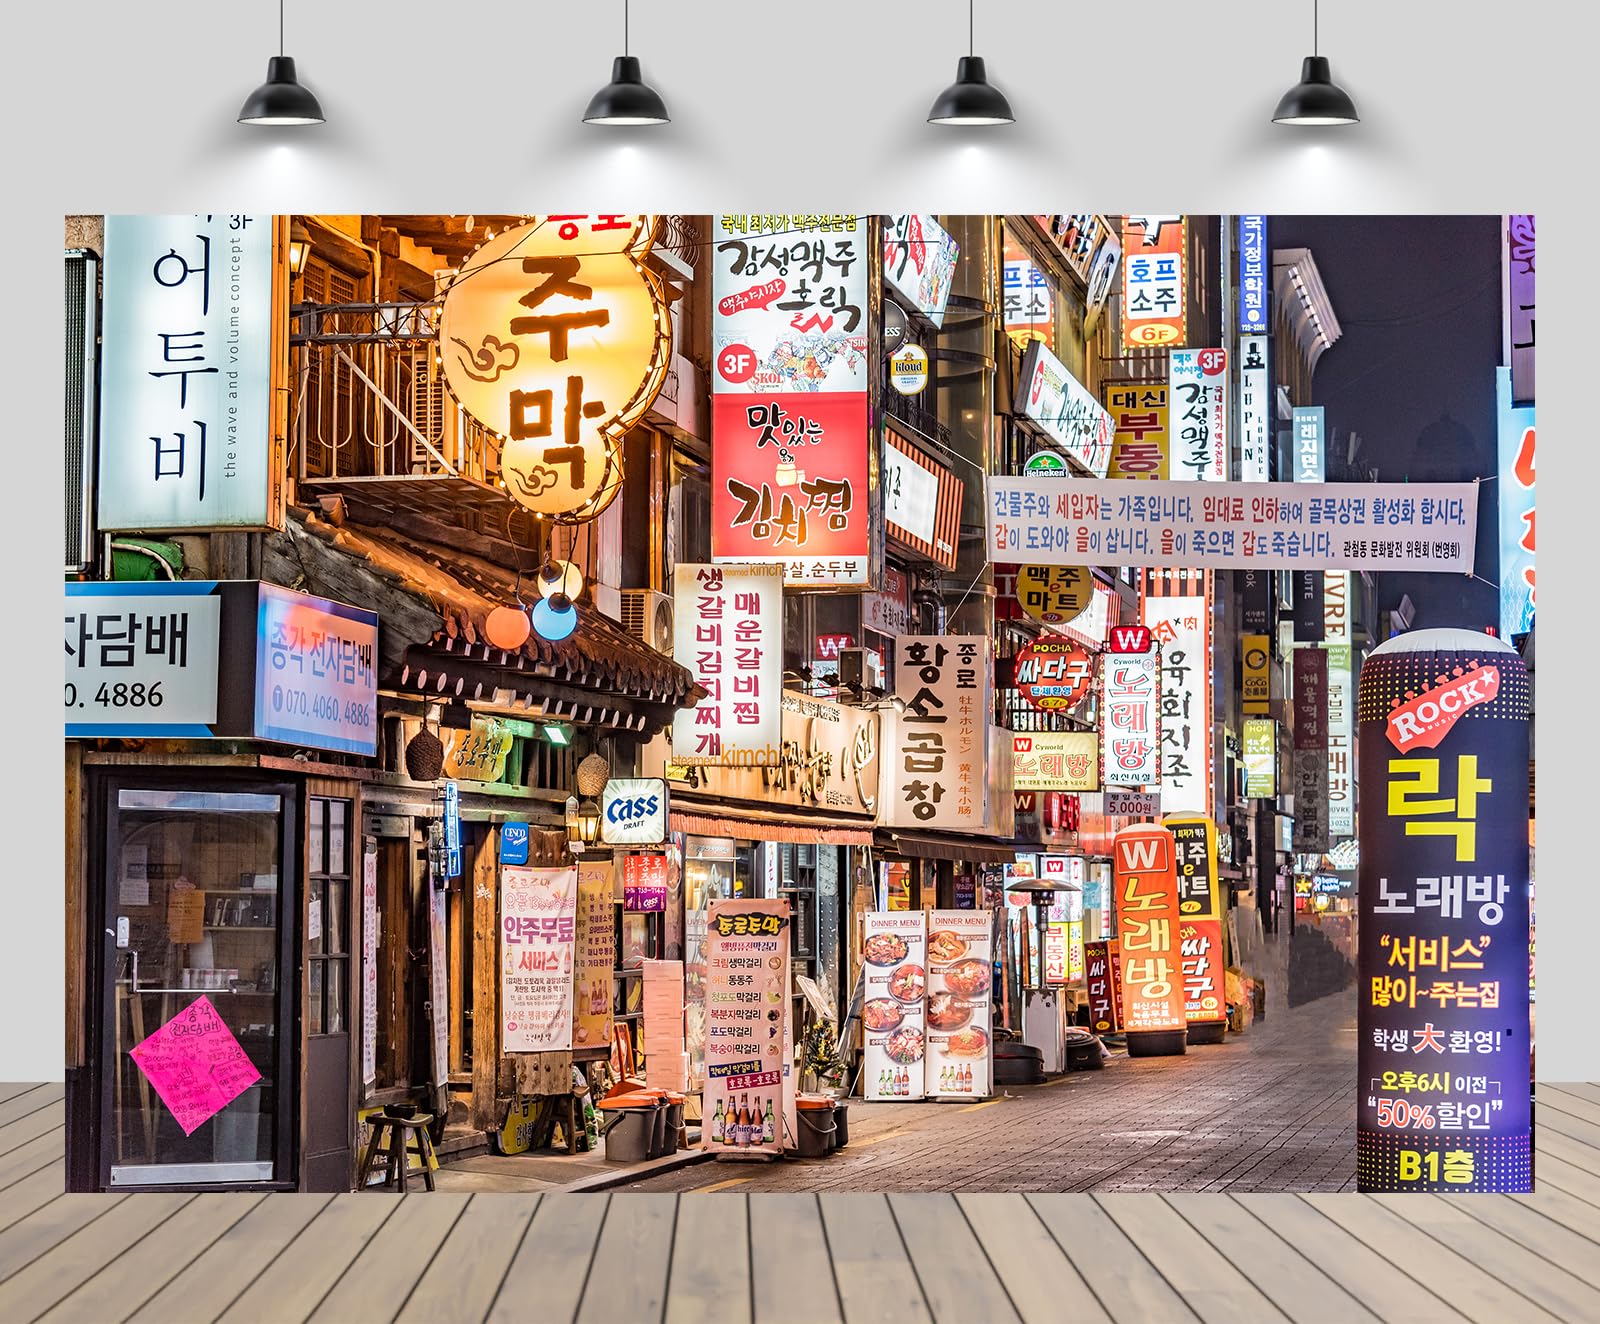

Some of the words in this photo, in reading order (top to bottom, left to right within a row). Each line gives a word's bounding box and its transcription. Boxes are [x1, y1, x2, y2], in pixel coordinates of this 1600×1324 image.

[721, 215, 748, 234] 국내
[751, 215, 789, 234] 최저가
[229, 236, 243, 301] concept
[717, 239, 858, 283] 감성맥주
[1129, 259, 1177, 284] 호프
[1243, 216, 1264, 309] 국가정보학원
[1131, 287, 1177, 313] 소주
[230, 305, 240, 364] volume
[1141, 327, 1169, 341] 6F
[148, 215, 219, 502] 어투비
[510, 256, 610, 489] 주막
[724, 354, 750, 375] 3F
[1202, 352, 1225, 369] 3F
[228, 370, 238, 399] and
[1112, 390, 1167, 409] 대신
[228, 406, 238, 446] wave
[746, 402, 824, 447] 맛있는
[1243, 375, 1253, 461] LUPIN
[1115, 413, 1163, 480] 부동
[224, 451, 236, 478] the
[727, 478, 853, 547] 김치찜
[994, 490, 1050, 519] 건물주와
[1056, 493, 1113, 521] 세입자는
[1118, 495, 1193, 522] 가족입니다.
[1203, 496, 1245, 523] 임대료
[1251, 497, 1303, 524] 인하하여
[1309, 498, 1366, 525] 골목상권
[1372, 498, 1415, 525] 활성화
[1421, 498, 1466, 525] 합시다.
[994, 523, 1020, 551] 갑이
[1026, 526, 1069, 551] 도와야
[1075, 526, 1101, 552] 을이
[1105, 528, 1154, 555] 삽니다.
[1160, 528, 1187, 555] 을이
[1192, 530, 1235, 556] 죽으면
[1242, 531, 1268, 557] 갑도
[1271, 531, 1335, 558] 죽습니다.
[1343, 541, 1367, 558] 관철동
[1370, 541, 1403, 558] 문화발전
[1406, 541, 1430, 558] 위원회
[1027, 566, 1080, 587] 맥주
[1027, 592, 1079, 611] 마트
[270, 621, 305, 674] 종각
[309, 631, 372, 688] 전자담배
[1033, 644, 1072, 653] POCHA
[1117, 630, 1143, 650] W
[695, 568, 726, 756] 생갈비김치찌개
[733, 592, 763, 725] 매운갈비찜
[956, 643, 977, 689] 종로
[1017, 656, 1090, 689] 싸다구
[1113, 658, 1141, 666] Cyworld
[95, 681, 163, 707] 4886
[286, 689, 309, 717] 070.
[313, 694, 341, 723] 4060.
[345, 701, 370, 727] 4886
[1109, 668, 1153, 770] 노래방
[1391, 680, 1485, 744] ROCK
[1426, 713, 1458, 731] MUSIC
[902, 642, 950, 821] 황소곱창
[1015, 739, 1030, 751] W
[1014, 754, 1092, 778] 노래방
[1387, 755, 1493, 862] 락
[623, 820, 645, 830] DRAFT
[1048, 862, 1062, 871] W
[1121, 840, 1159, 870] W
[1373, 875, 1510, 925] 노래방
[504, 916, 574, 944] 안주무료
[900, 919, 920, 927] MENU
[935, 917, 962, 925] DINNER
[964, 917, 987, 925] MENU
[1046, 926, 1064, 978] 부동산
[1122, 878, 1176, 999] 노래방
[518, 951, 559, 972] 서비스
[711, 958, 763, 969] 크림생막걸리
[711, 992, 762, 1003] 청포도막걸리
[1089, 959, 1110, 1019] 싸다구
[1371, 975, 1500, 1009] 많이~주는집
[189, 1005, 212, 1023] 종각
[710, 1009, 761, 1020] 복분자막걸리
[710, 1026, 752, 1037] 포도막걸리
[1373, 1029, 1409, 1053] 학생
[1411, 1023, 1446, 1054] 大
[1448, 1029, 1501, 1054] 환영!
[710, 1044, 760, 1055] 복숭아막걸리
[1381, 1071, 1450, 1095] 오후6시
[1455, 1076, 1487, 1094] 이전
[1400, 1149, 1475, 1184] B1층
